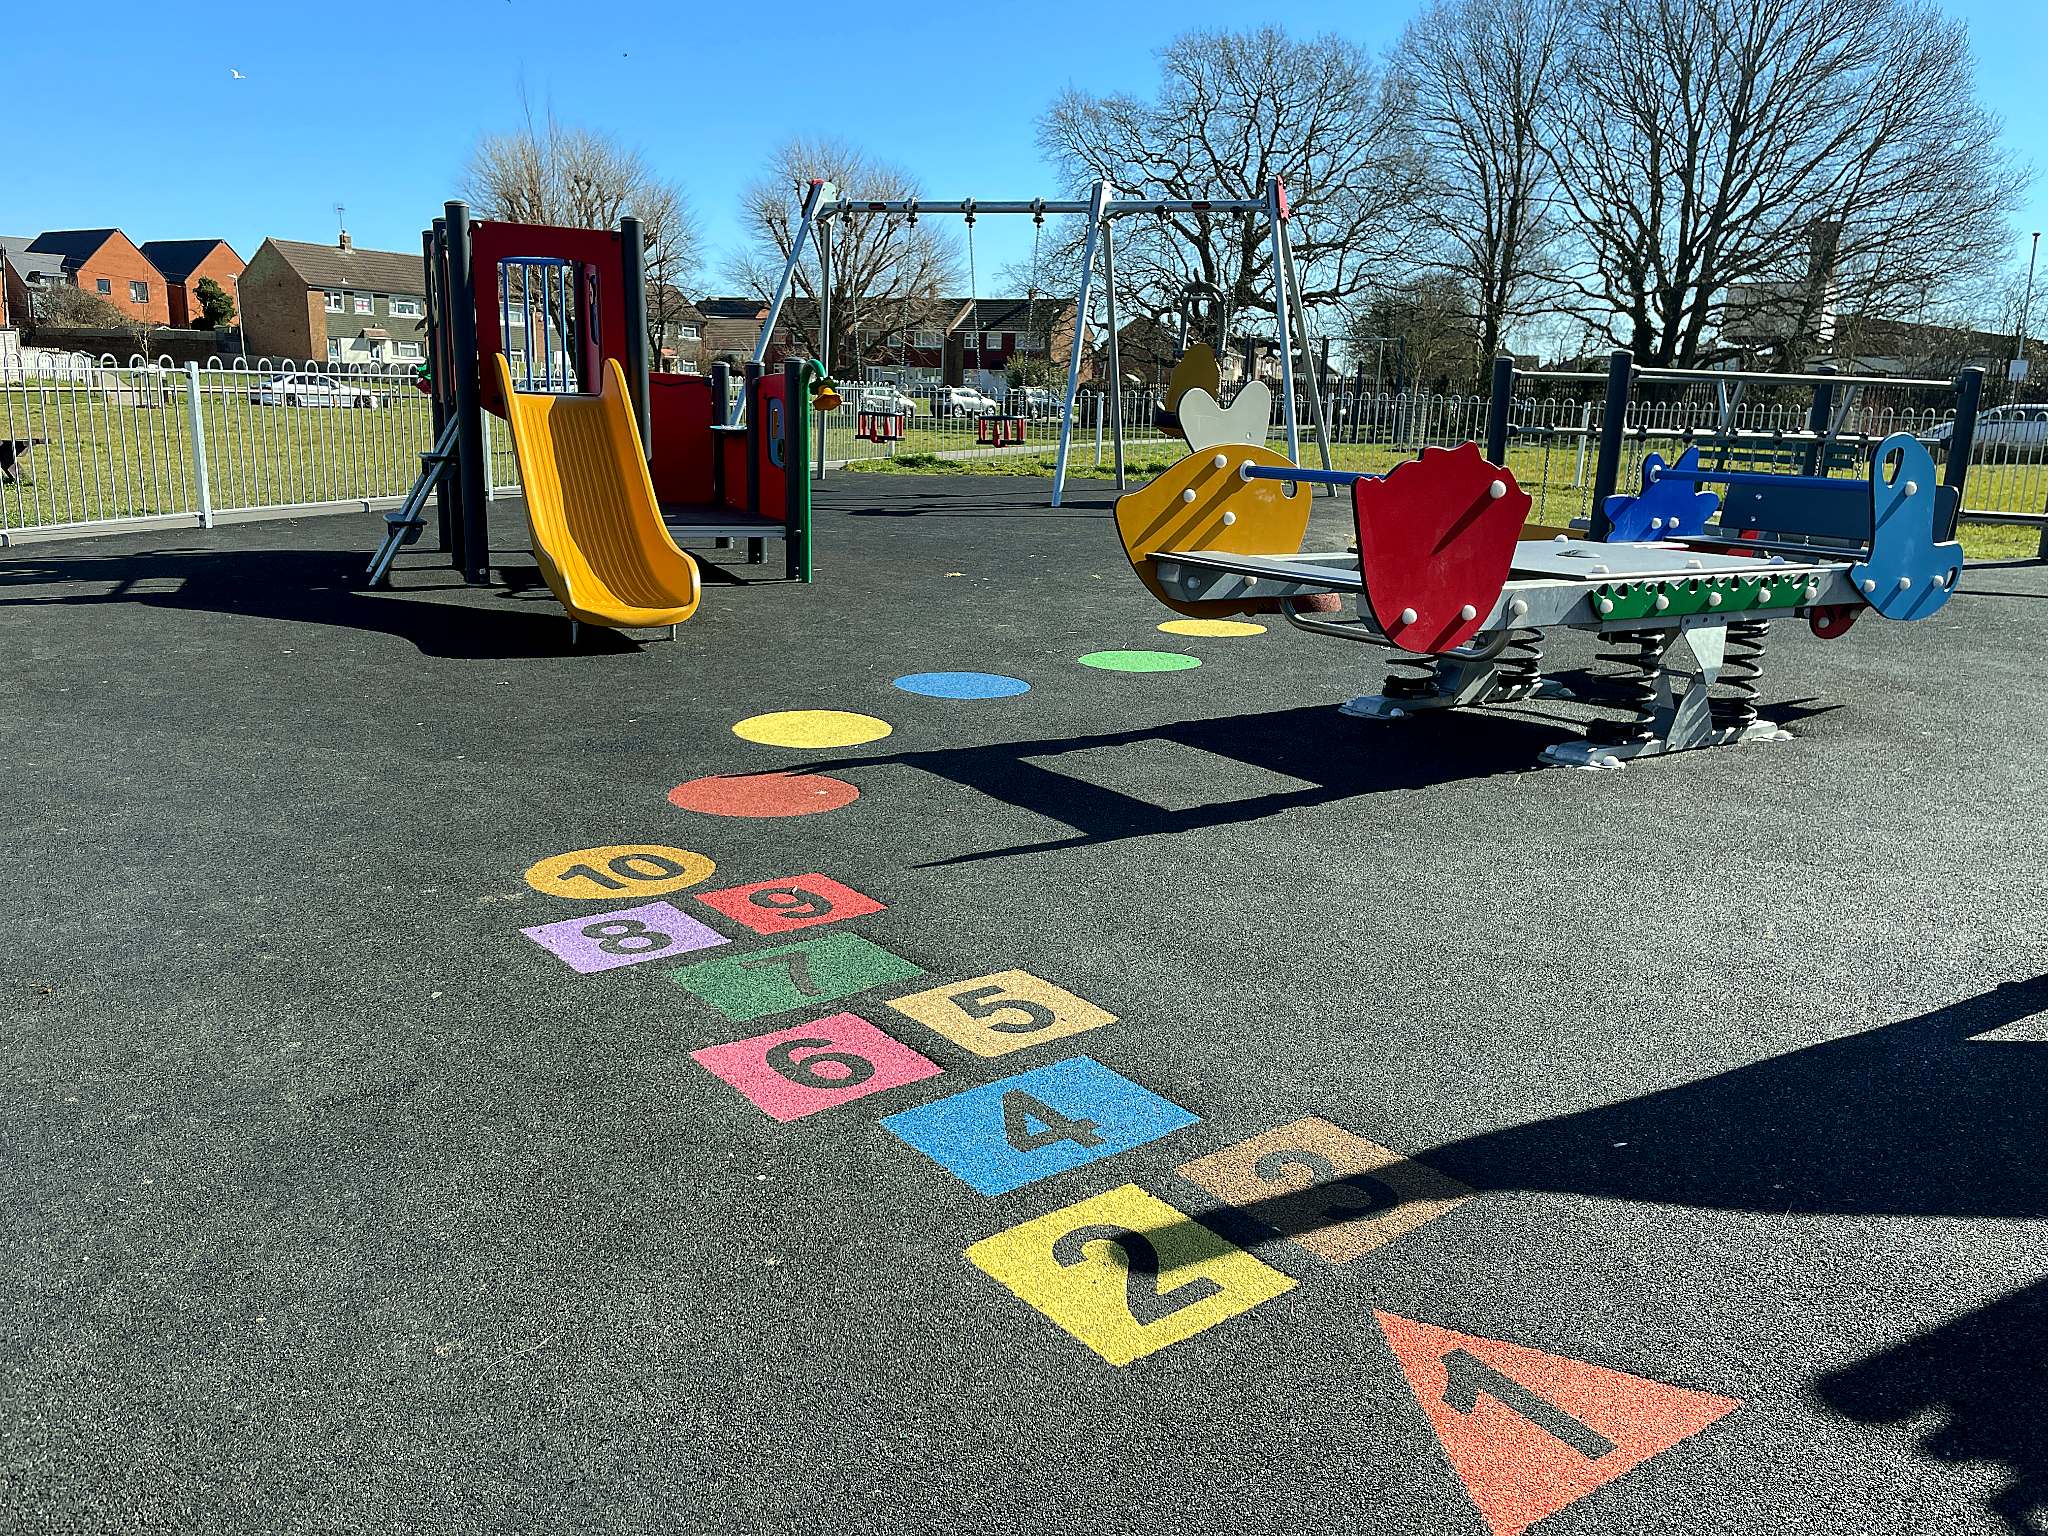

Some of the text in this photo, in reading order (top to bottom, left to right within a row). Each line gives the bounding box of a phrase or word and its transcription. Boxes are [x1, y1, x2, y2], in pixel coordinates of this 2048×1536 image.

[558, 854, 685, 891] 10
[749, 886, 833, 918] 9
[581, 919, 673, 955] 8
[741, 952, 825, 997] 7
[949, 985, 1056, 1033] 5
[766, 1038, 876, 1089] 6
[1001, 1089, 1103, 1153] 4
[1255, 1150, 1398, 1221] 3
[1052, 1223, 1222, 1326] 2
[1440, 1348, 1618, 1460] 1
